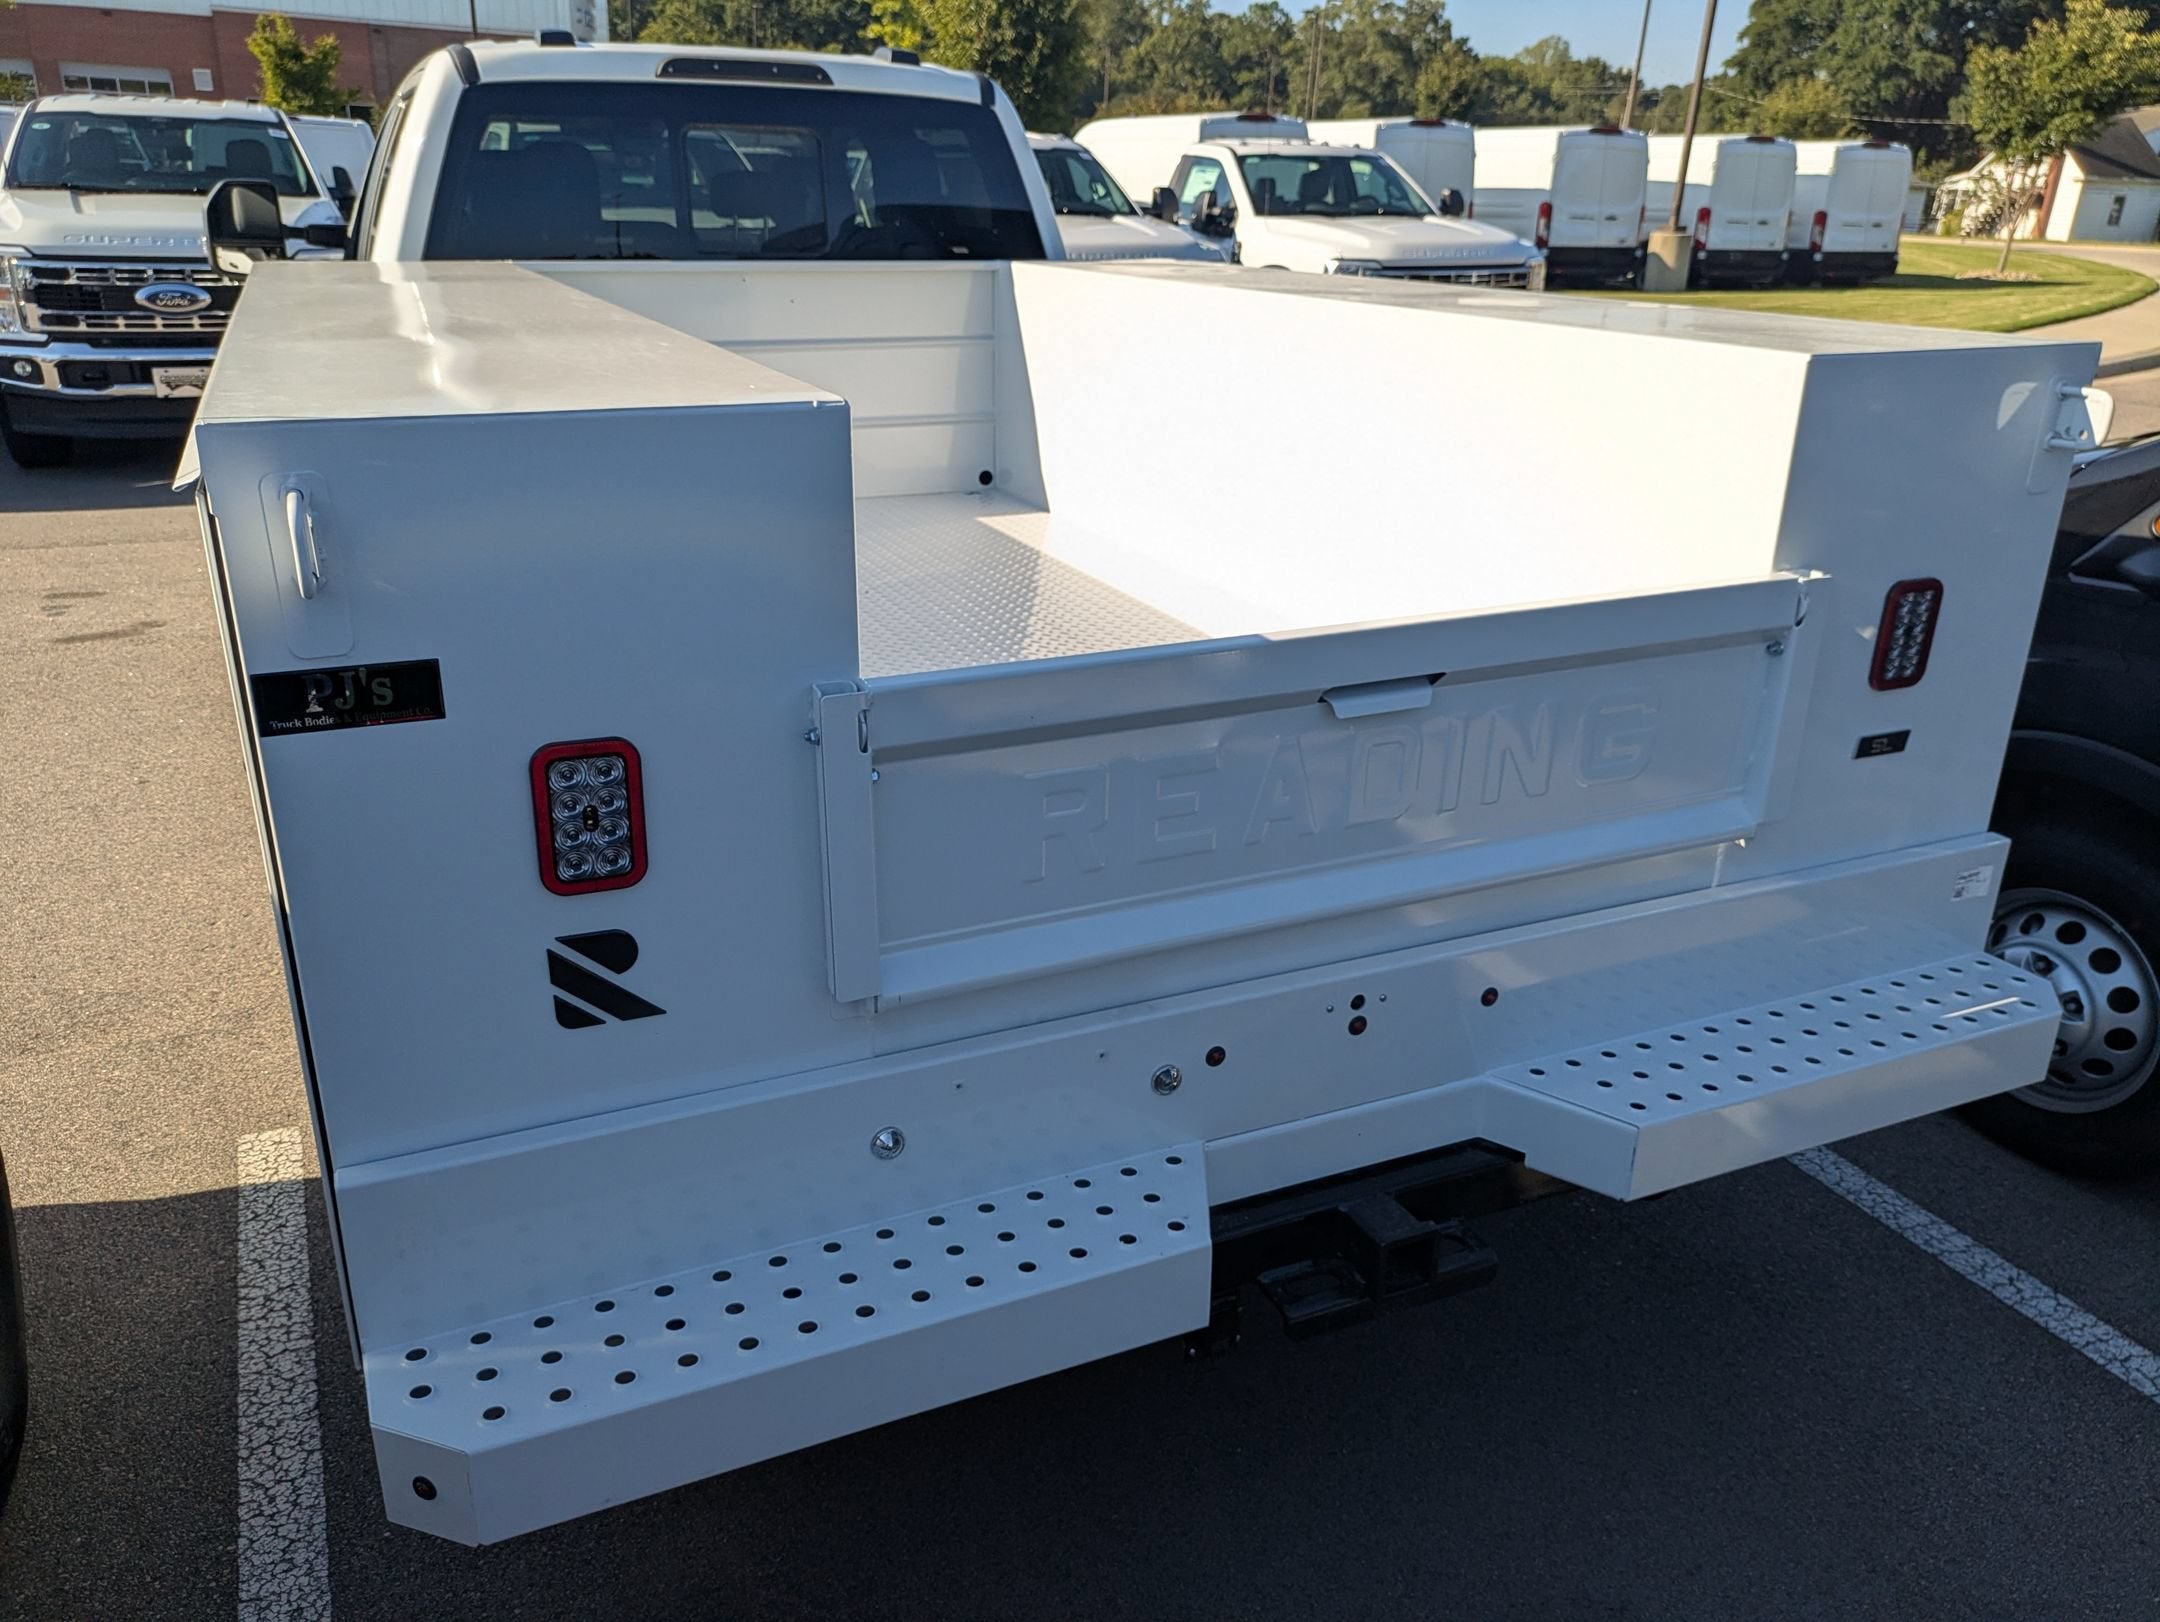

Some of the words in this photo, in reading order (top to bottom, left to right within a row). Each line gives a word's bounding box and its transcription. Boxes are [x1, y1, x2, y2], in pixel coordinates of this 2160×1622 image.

[156, 292, 191, 306] Ford
[301, 667, 395, 713] PJ's
[269, 718, 302, 730] Truck
[1021, 691, 1664, 884] READING
